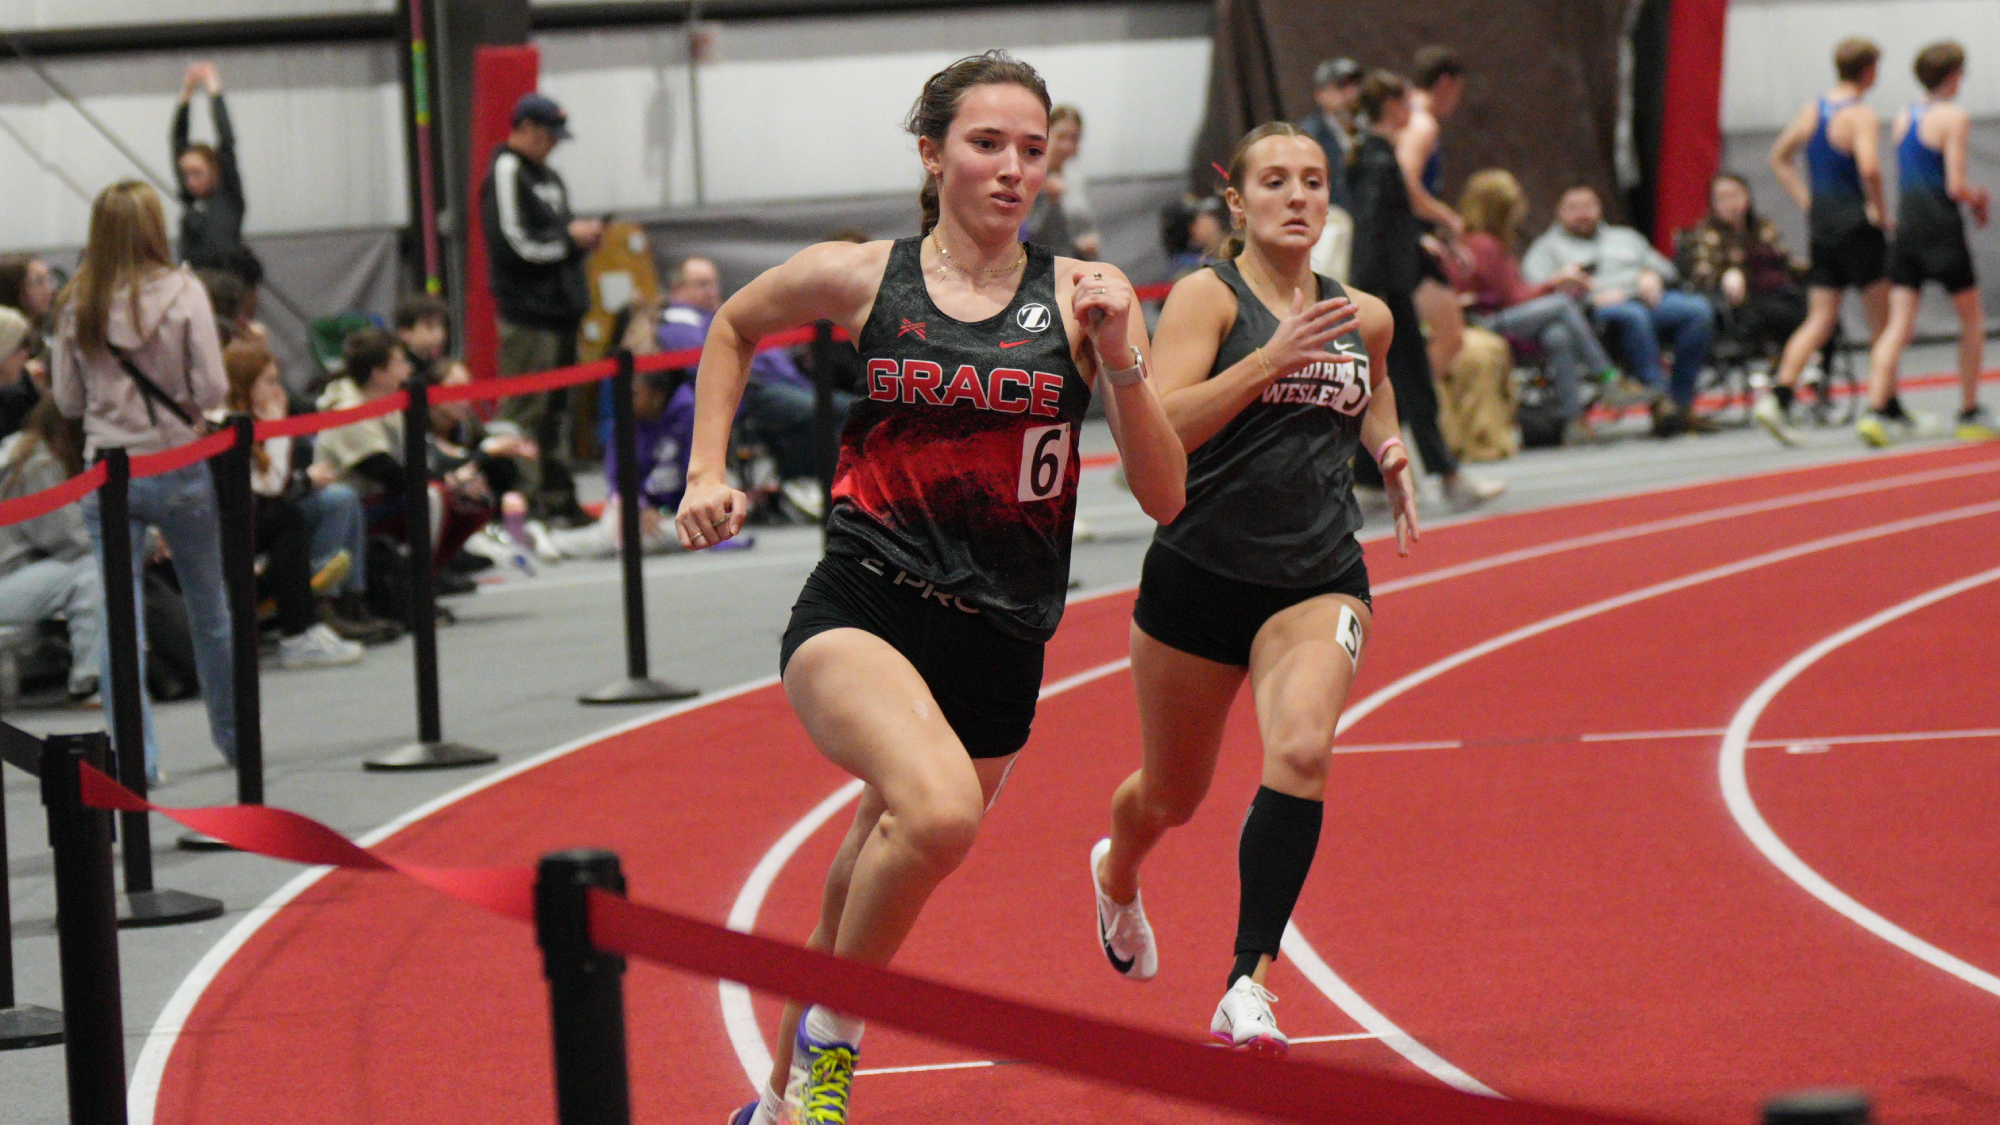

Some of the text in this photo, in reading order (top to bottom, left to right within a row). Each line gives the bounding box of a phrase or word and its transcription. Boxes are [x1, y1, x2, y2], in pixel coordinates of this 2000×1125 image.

[867, 358, 1064, 418] GRACE
[1341, 357, 1367, 411] 5
[1030, 428, 1062, 497] 6
[1344, 614, 1361, 660] 5
